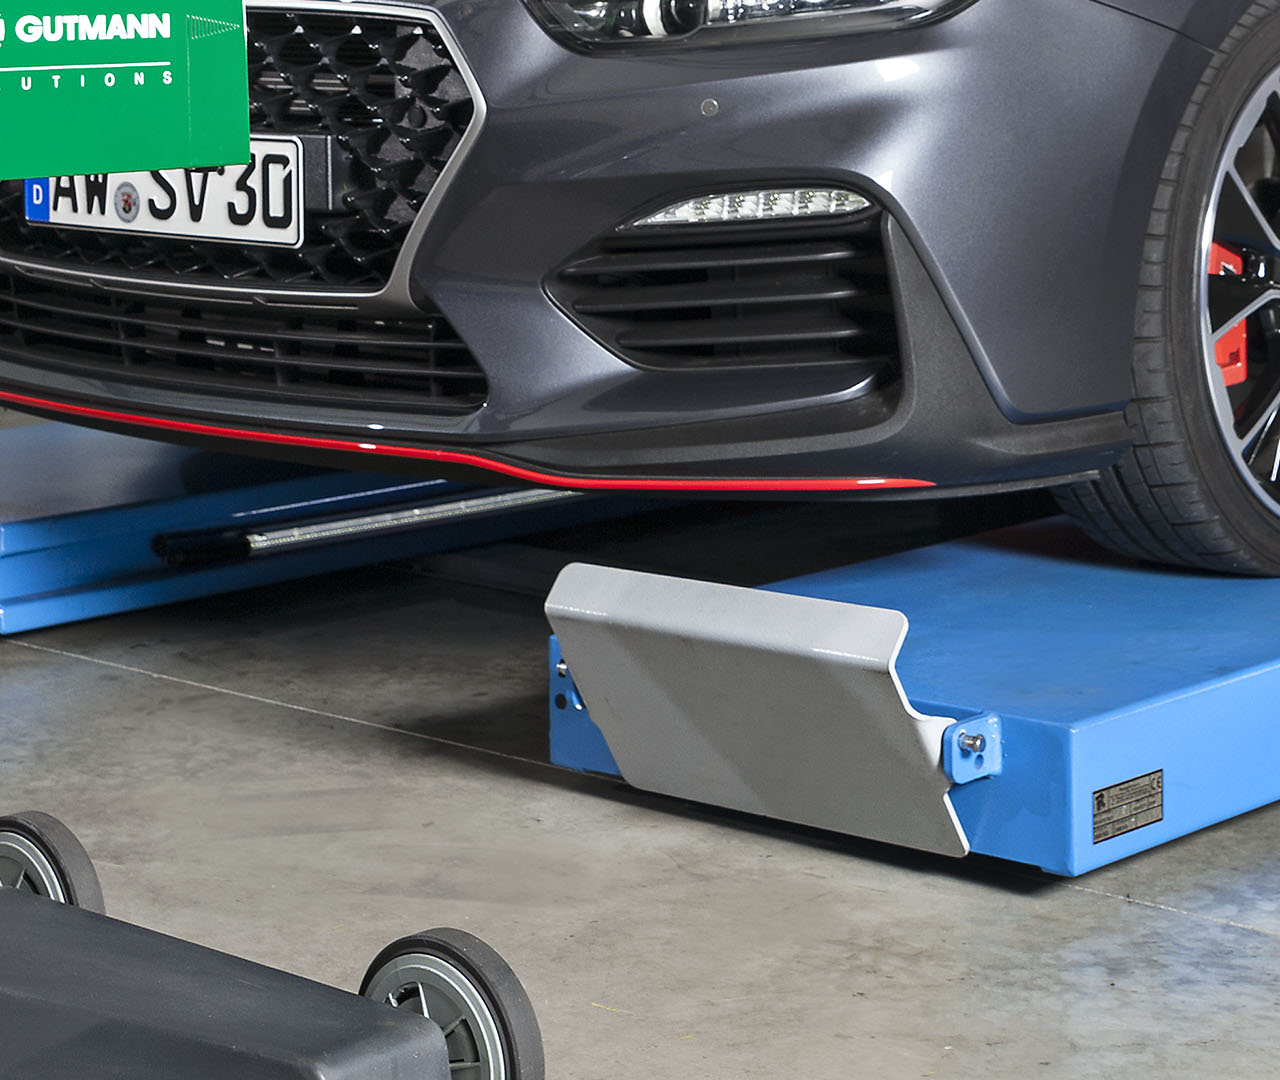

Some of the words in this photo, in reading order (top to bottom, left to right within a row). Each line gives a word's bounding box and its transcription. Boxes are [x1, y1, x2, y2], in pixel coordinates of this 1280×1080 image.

[15, 13, 171, 43] GUTMANN
[32, 184, 43, 206] D
[227, 152, 293, 229] 30
